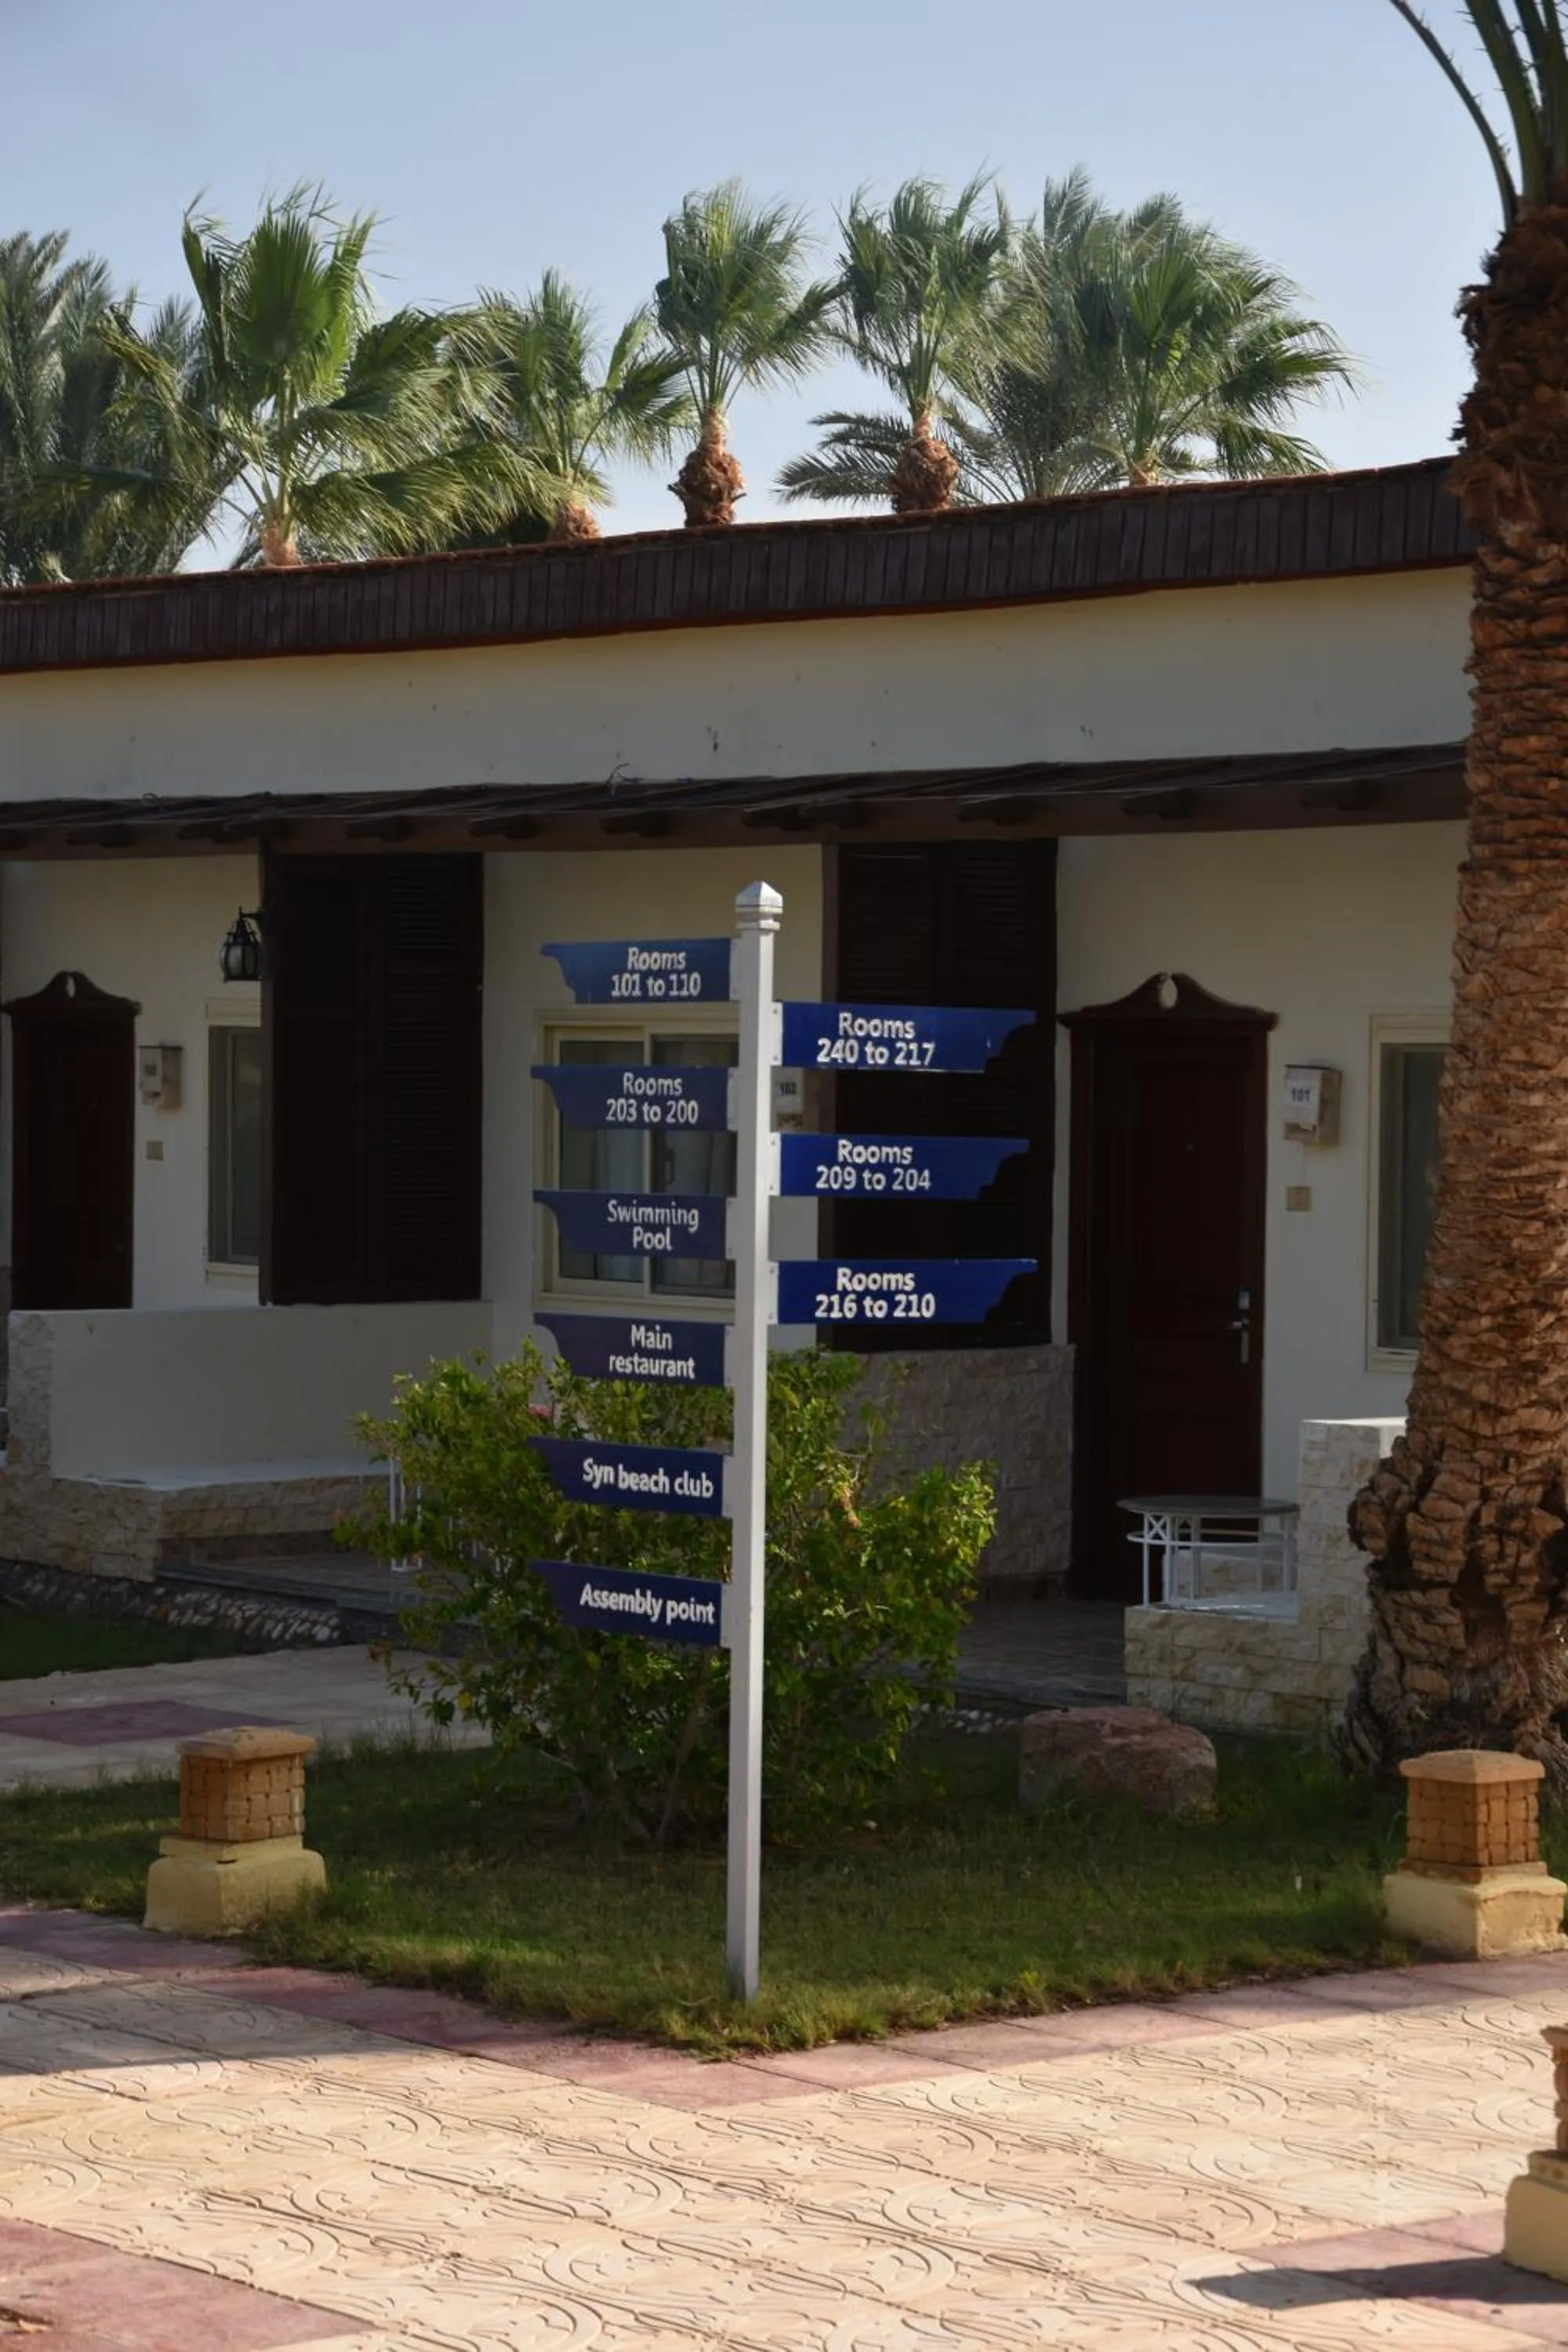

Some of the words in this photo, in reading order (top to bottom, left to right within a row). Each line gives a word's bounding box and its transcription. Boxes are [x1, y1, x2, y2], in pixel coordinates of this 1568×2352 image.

[627, 947, 686, 971] Rooms
[611, 973, 641, 996] 101
[647, 976, 665, 996] to
[669, 972, 701, 996] 110
[838, 1012, 916, 1039] Rooms
[816, 1038, 858, 1063] 240
[865, 1041, 889, 1064] to
[894, 1042, 936, 1066] 217
[623, 1072, 683, 1097] Rooms
[605, 1098, 637, 1122] 203
[642, 1102, 661, 1123] to
[666, 1100, 699, 1124] 200
[837, 1139, 913, 1164] Rooms
[815, 1166, 856, 1189] 209
[862, 1168, 886, 1190] to
[891, 1168, 931, 1191] 204
[607, 1199, 699, 1233] Swimming
[633, 1226, 673, 1250] Pool
[836, 1267, 916, 1291] Rooms
[815, 1294, 857, 1318] 216
[863, 1295, 887, 1318] to
[892, 1294, 936, 1318] 210
[630, 1324, 672, 1350] Main
[608, 1352, 695, 1379] restaurant
[583, 1457, 614, 1489] Syn
[618, 1464, 670, 1494] beach
[674, 1470, 713, 1498] club
[579, 1582, 662, 1623] Assembly
[666, 1597, 715, 1626] point
